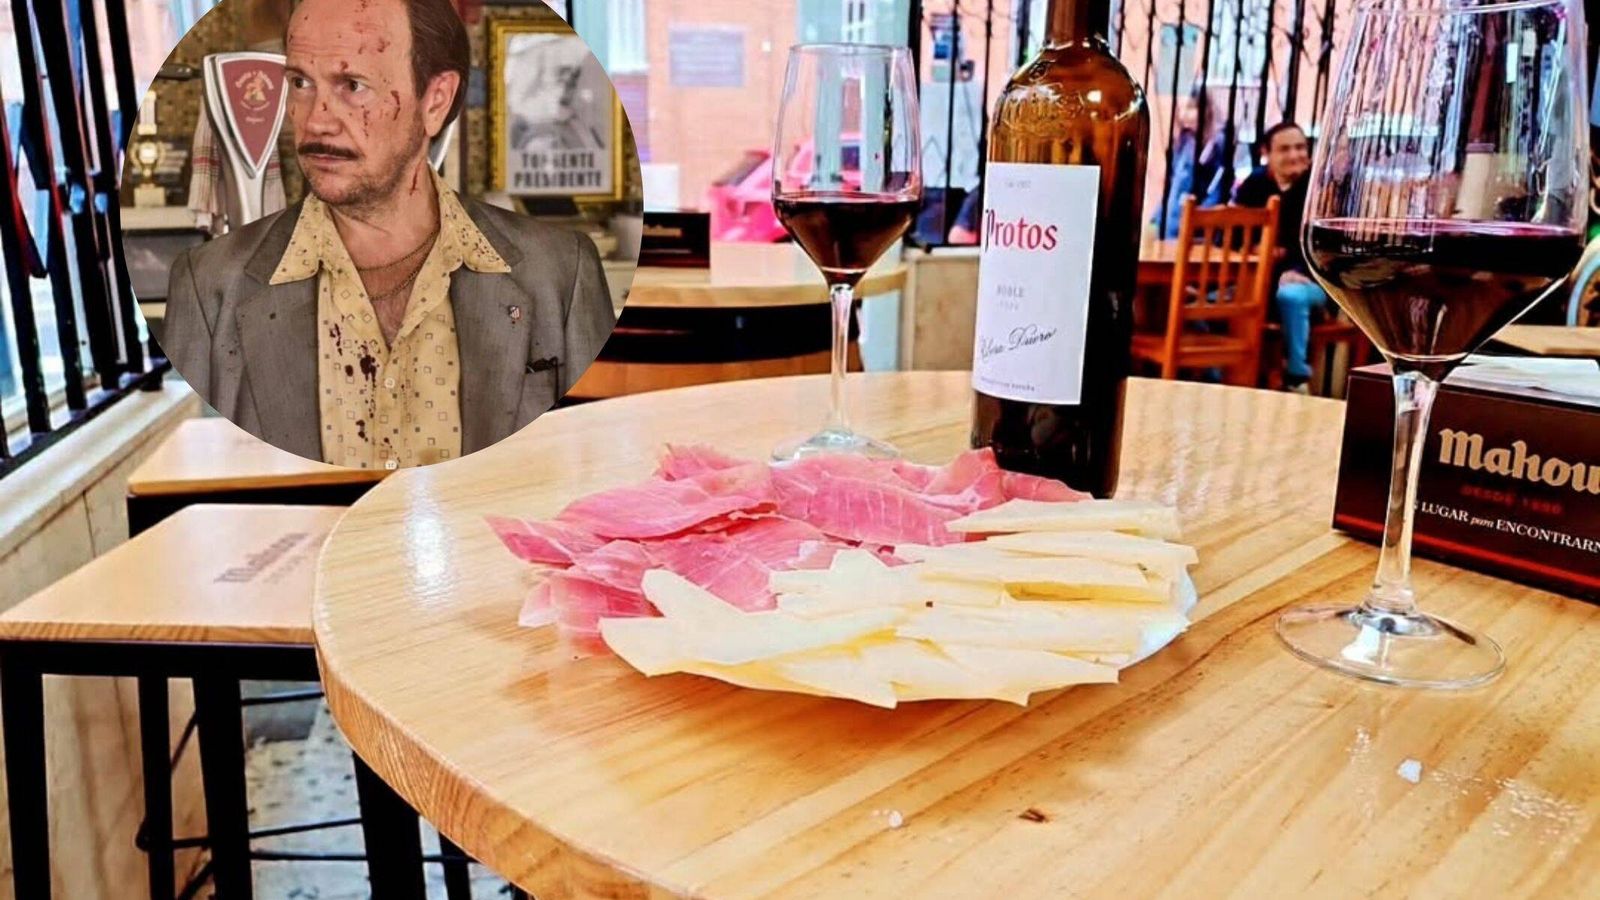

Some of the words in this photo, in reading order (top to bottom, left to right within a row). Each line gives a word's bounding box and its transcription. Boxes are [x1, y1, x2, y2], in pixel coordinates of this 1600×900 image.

[514, 172, 602, 188] PRESIDENTE
[985, 208, 1058, 253] Protos
[1438, 428, 1600, 495] Mahou
[1421, 500, 1469, 522] LUGAR
[1470, 516, 1495, 528] para
